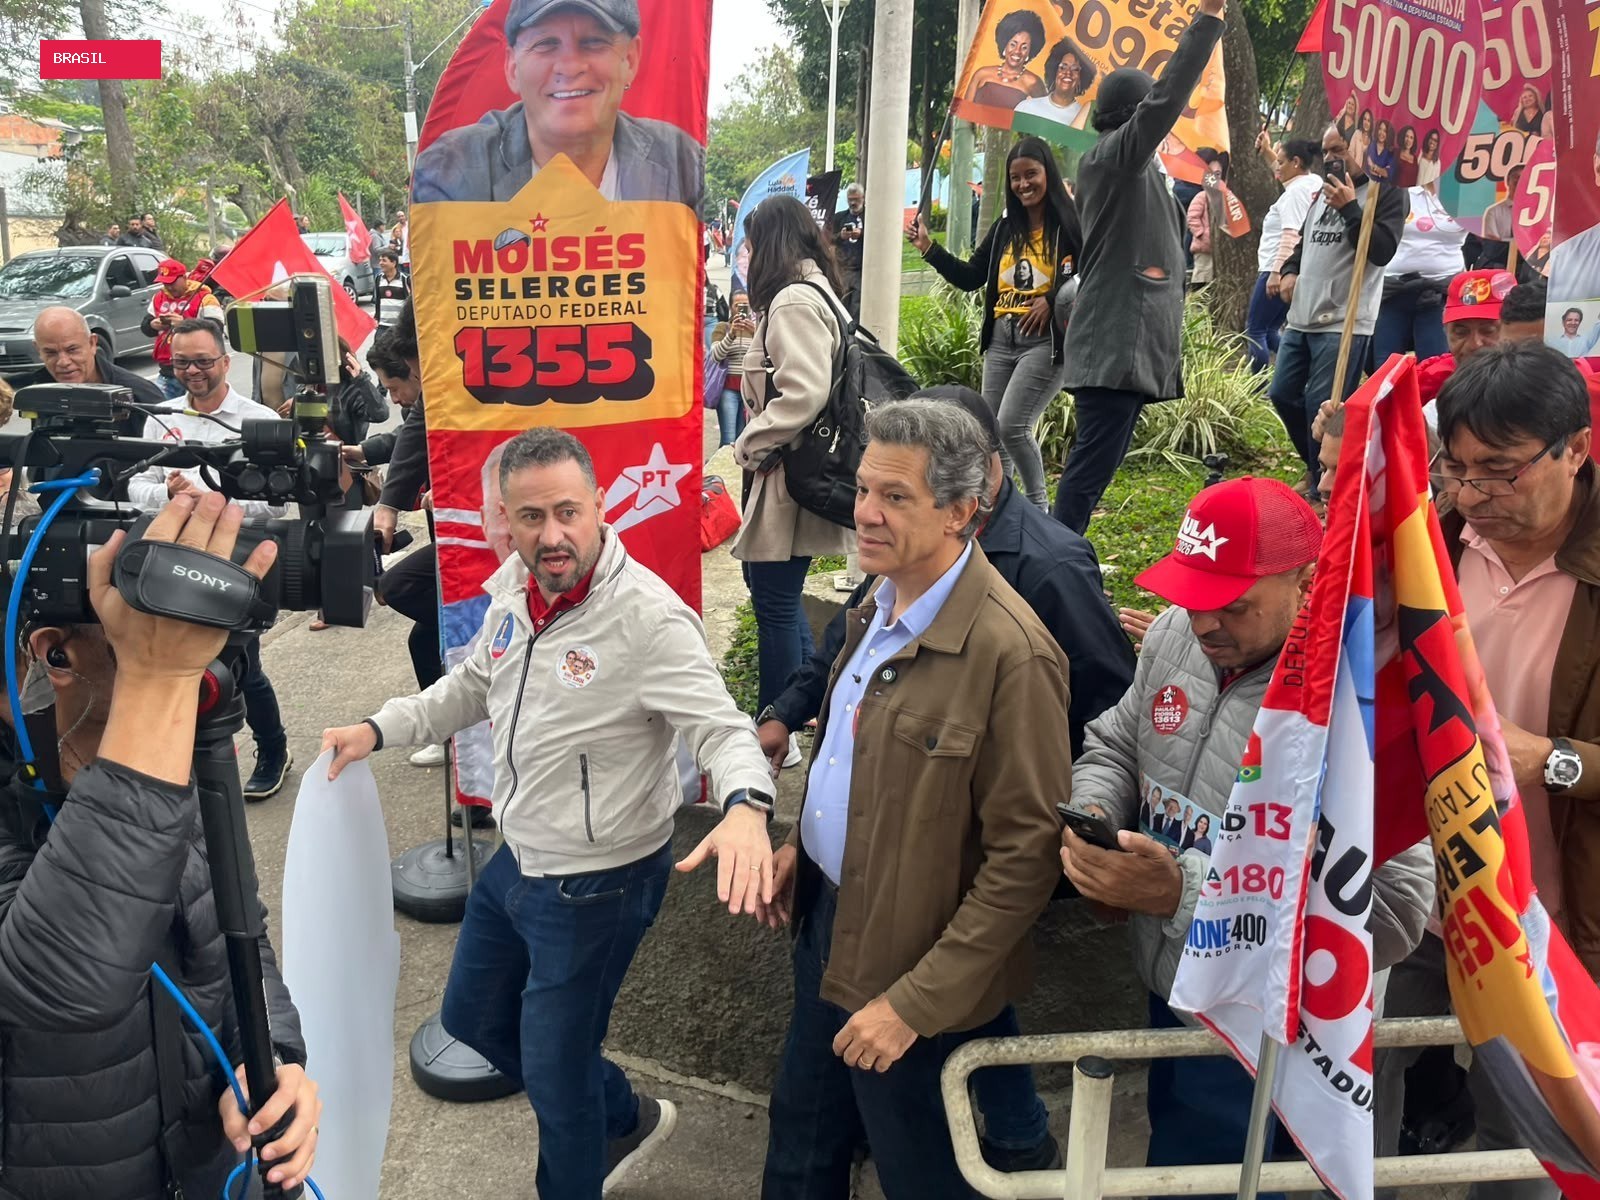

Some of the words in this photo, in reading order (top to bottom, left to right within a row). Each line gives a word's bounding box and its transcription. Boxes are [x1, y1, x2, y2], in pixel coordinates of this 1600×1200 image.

[1108, 0, 1188, 43] eta
[1407, 0, 1466, 21] INISTA
[1327, 0, 1476, 135] 50000
[1518, 161, 1557, 227] 5
[453, 226, 646, 274] MOISÉS
[1311, 229, 1343, 246] Kappa
[455, 272, 646, 300] SELERGES
[457, 304, 552, 321] DEPUTADO
[559, 300, 648, 318] FEDERAL
[454, 321, 648, 397] 1355
[642, 470, 671, 488] PT
[172, 564, 232, 592] SONY
[1221, 812, 1246, 832] D
[1248, 802, 1294, 841] 13
[1223, 864, 1284, 900] 180
[1231, 913, 1267, 947] 400
